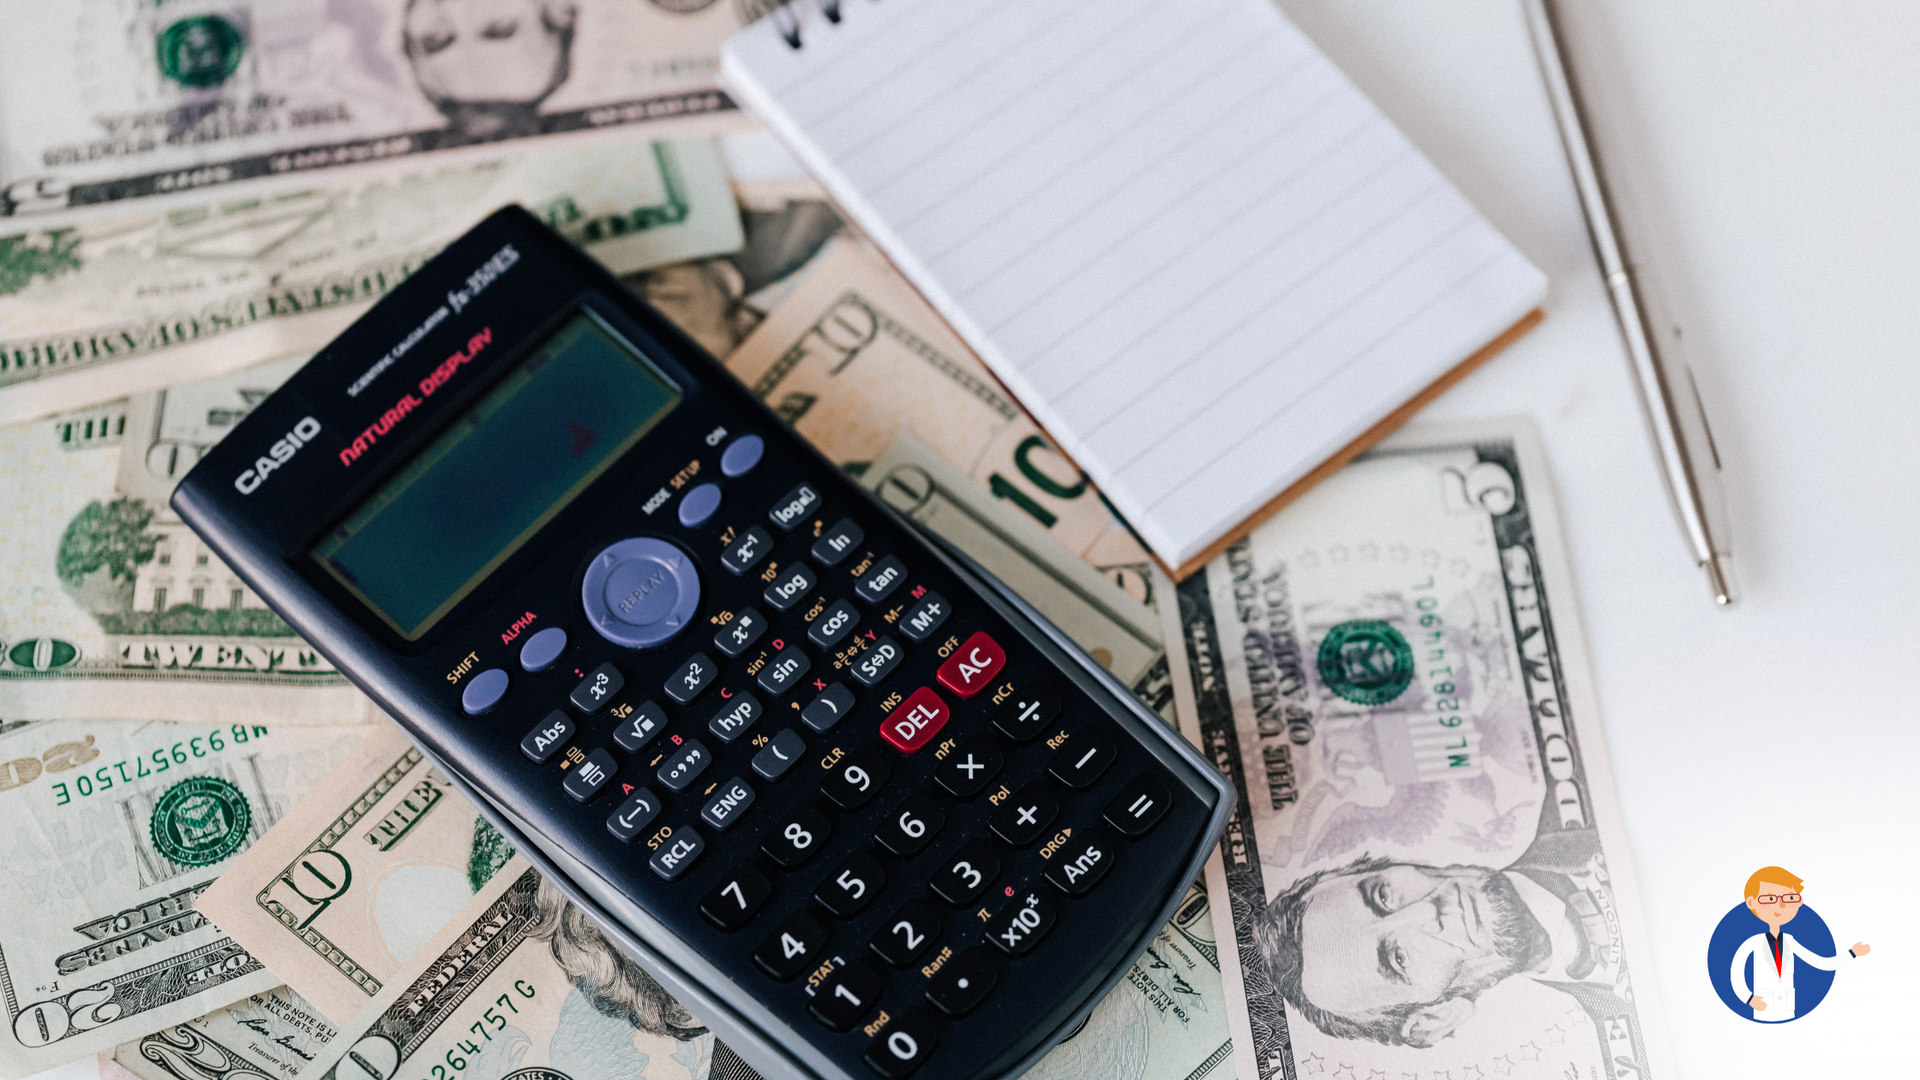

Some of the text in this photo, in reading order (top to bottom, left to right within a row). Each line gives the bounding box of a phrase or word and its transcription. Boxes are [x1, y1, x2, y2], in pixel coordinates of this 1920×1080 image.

[340, 325, 491, 466] NATURAL DISPLAY
[706, 427, 727, 445] ON
[233, 414, 321, 494] CASIO
[642, 461, 701, 514] MODE SETUP
[988, 435, 1087, 531] 10
[829, 535, 850, 551] ln
[617, 569, 667, 614] REPLAY
[775, 573, 808, 599] log
[869, 568, 898, 591] tan
[912, 585, 926, 599] M
[1411, 574, 1435, 592] L
[502, 612, 538, 646] ALPHA
[821, 609, 848, 635] cos
[911, 604, 940, 631] M+
[772, 639, 784, 650] D
[865, 630, 876, 640] Y
[938, 636, 961, 660] OFF
[119, 641, 335, 674] TWENT
[959, 648, 991, 682] AC
[1261, 562, 1316, 746] OF AMERICA
[447, 652, 481, 686] SHIFT
[773, 659, 798, 682] sin
[721, 688, 732, 698] C
[813, 678, 826, 691] X
[990, 679, 1013, 704] nCr
[1242, 631, 1285, 741] UNITED
[1500, 544, 1588, 831] DOLLARS
[880, 692, 904, 714] INS
[716, 703, 751, 733] hyp
[894, 704, 938, 742] DEL
[535, 722, 565, 751] Abs
[671, 735, 682, 745] B
[752, 734, 768, 747] %
[935, 739, 956, 760] nPr
[1047, 731, 1069, 749] Rec
[76, 729, 226, 797] 93957150
[821, 748, 845, 769] CLR
[1446, 736, 1471, 768] ML
[622, 783, 634, 795] A
[845, 766, 870, 791] 9
[1262, 743, 1300, 812] THE
[51, 782, 72, 807] E
[711, 785, 748, 820] ENG
[989, 785, 1010, 805] Pol
[784, 823, 812, 848] 8
[900, 812, 925, 837] 6
[648, 827, 675, 852] STO
[659, 838, 695, 869] RCL
[1064, 846, 1101, 884] Ans
[837, 870, 865, 899] 5
[953, 862, 981, 888] 3
[721, 881, 746, 909] 7
[892, 921, 924, 950] 2
[1594, 888, 1623, 965] LINCOLN
[781, 933, 806, 959] 4
[1168, 941, 1197, 972] Treasurer
[404, 905, 518, 1016] FEDERAL
[808, 958, 835, 988] STAT
[514, 979, 536, 999] G
[835, 984, 861, 1006] 1
[1126, 969, 1168, 1014] THIS NOTE
[1158, 990, 1175, 1008] ALL
[13, 977, 122, 1050] 20
[264, 1001, 281, 1018] ALL
[269, 995, 291, 1011] THIS
[291, 1008, 316, 1027] NOTE
[315, 1021, 327, 1032] IS
[1172, 1004, 1191, 1024] FOR
[864, 1011, 892, 1038] Rnd
[248, 1042, 281, 1066] Treasurer
[888, 1032, 917, 1060] 0
